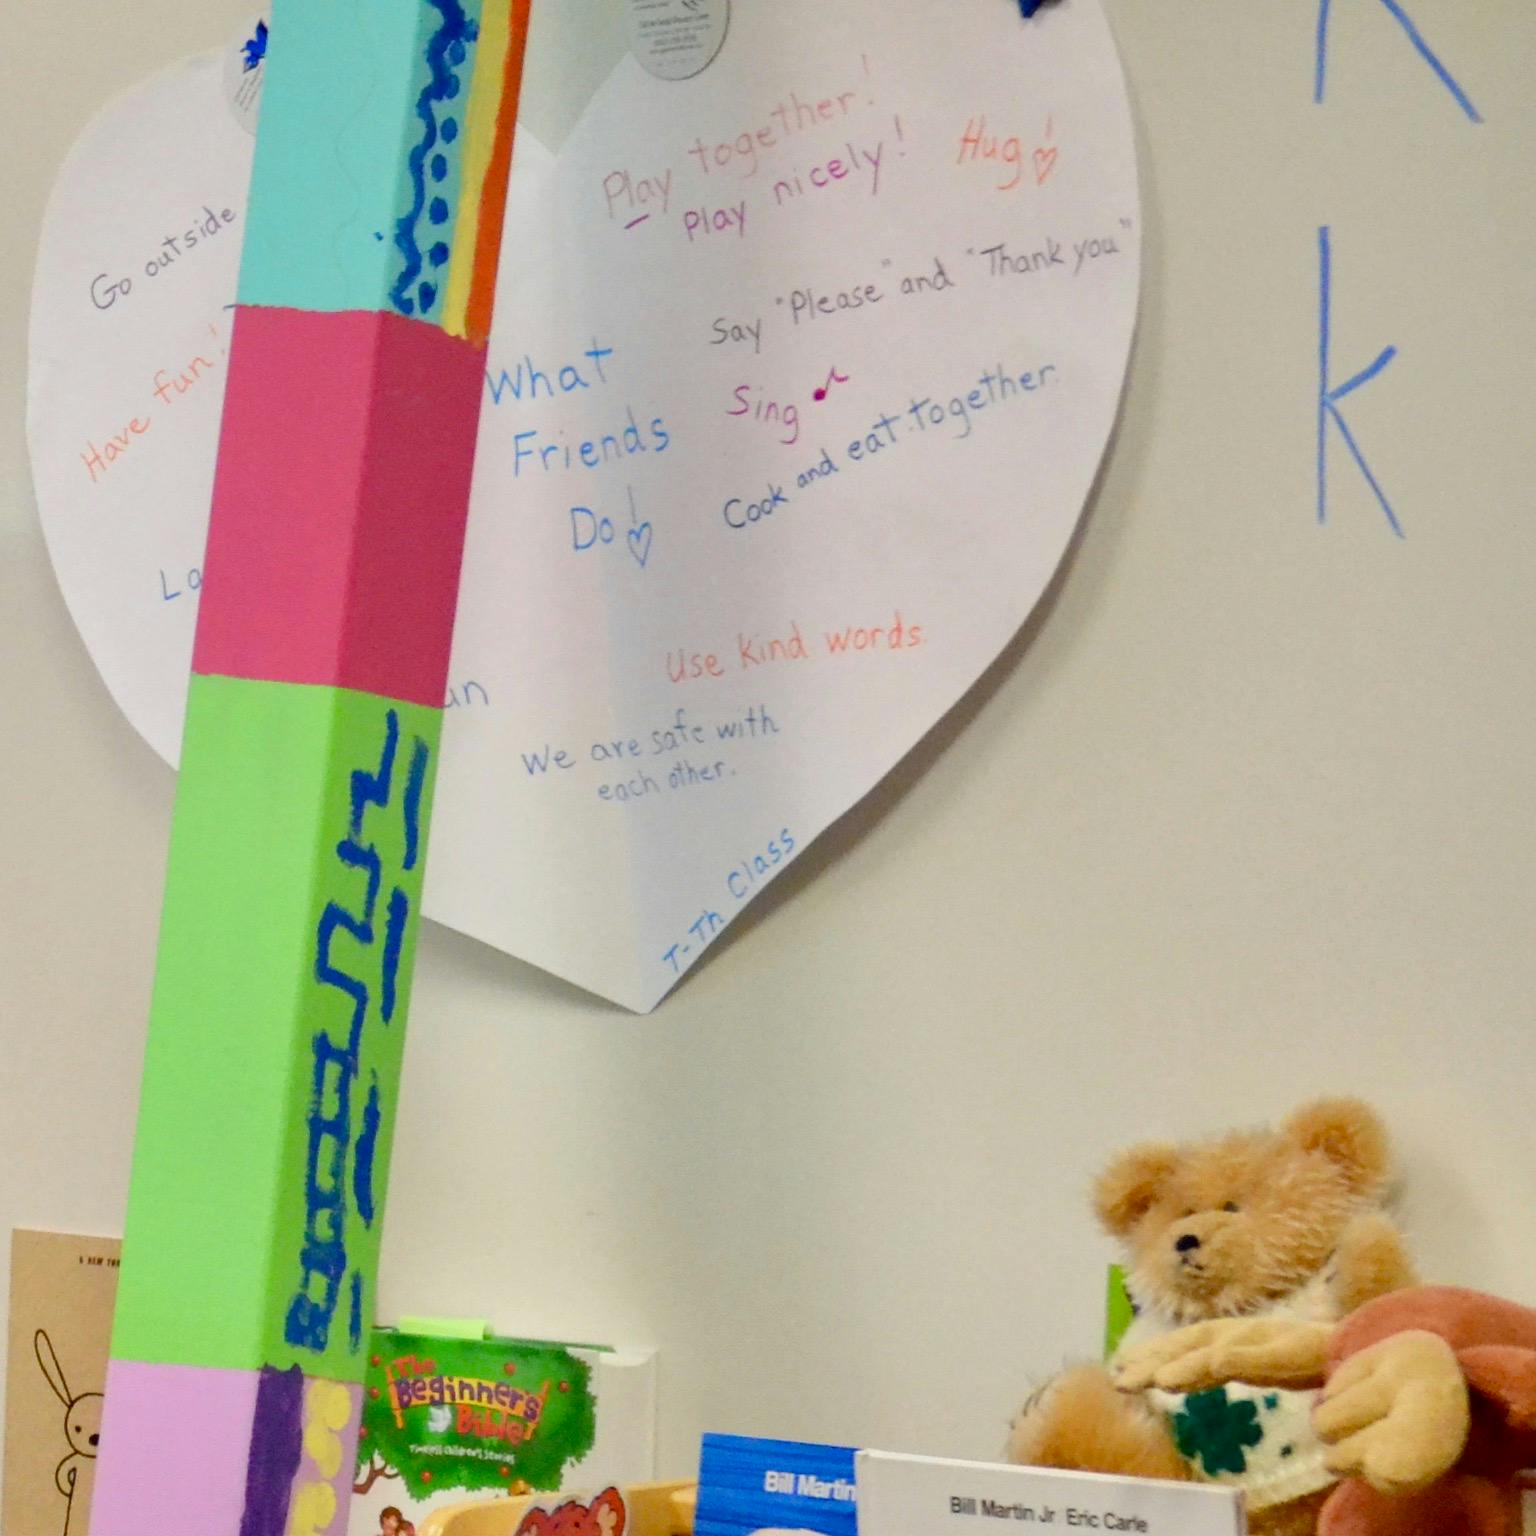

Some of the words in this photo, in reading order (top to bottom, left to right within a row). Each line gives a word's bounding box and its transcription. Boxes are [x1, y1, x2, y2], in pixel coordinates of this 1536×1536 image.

[602, 166, 674, 219] Play
[90, 273, 133, 311] Go
[145, 205, 237, 277] outside
[709, 316, 763, 354] Say
[899, 256, 956, 293] and
[484, 336, 614, 406] What
[511, 404, 671, 478] Friends
[727, 385, 803, 445] Sing
[79, 414, 152, 483] Have
[722, 482, 791, 531] Cook
[797, 448, 841, 490] and
[846, 411, 902, 464] eat
[665, 648, 725, 685] Use
[521, 746, 577, 777] We
[590, 735, 642, 764] are
[651, 707, 705, 757] safe
[715, 706, 780, 744] with
[596, 769, 660, 802] each
[667, 755, 737, 791] other.
[727, 826, 798, 901] Class
[393, 1354, 436, 1378] The
[456, 1403, 525, 1446] Bible
[764, 1470, 794, 1494] Bill
[797, 1475, 856, 1501] Martin
[949, 1496, 977, 1516] Bill
[980, 1499, 1036, 1522] Martin
[1039, 1502, 1056, 1524] Jr
[1065, 1506, 1100, 1529] Eric
[1103, 1511, 1150, 1534] Carle
